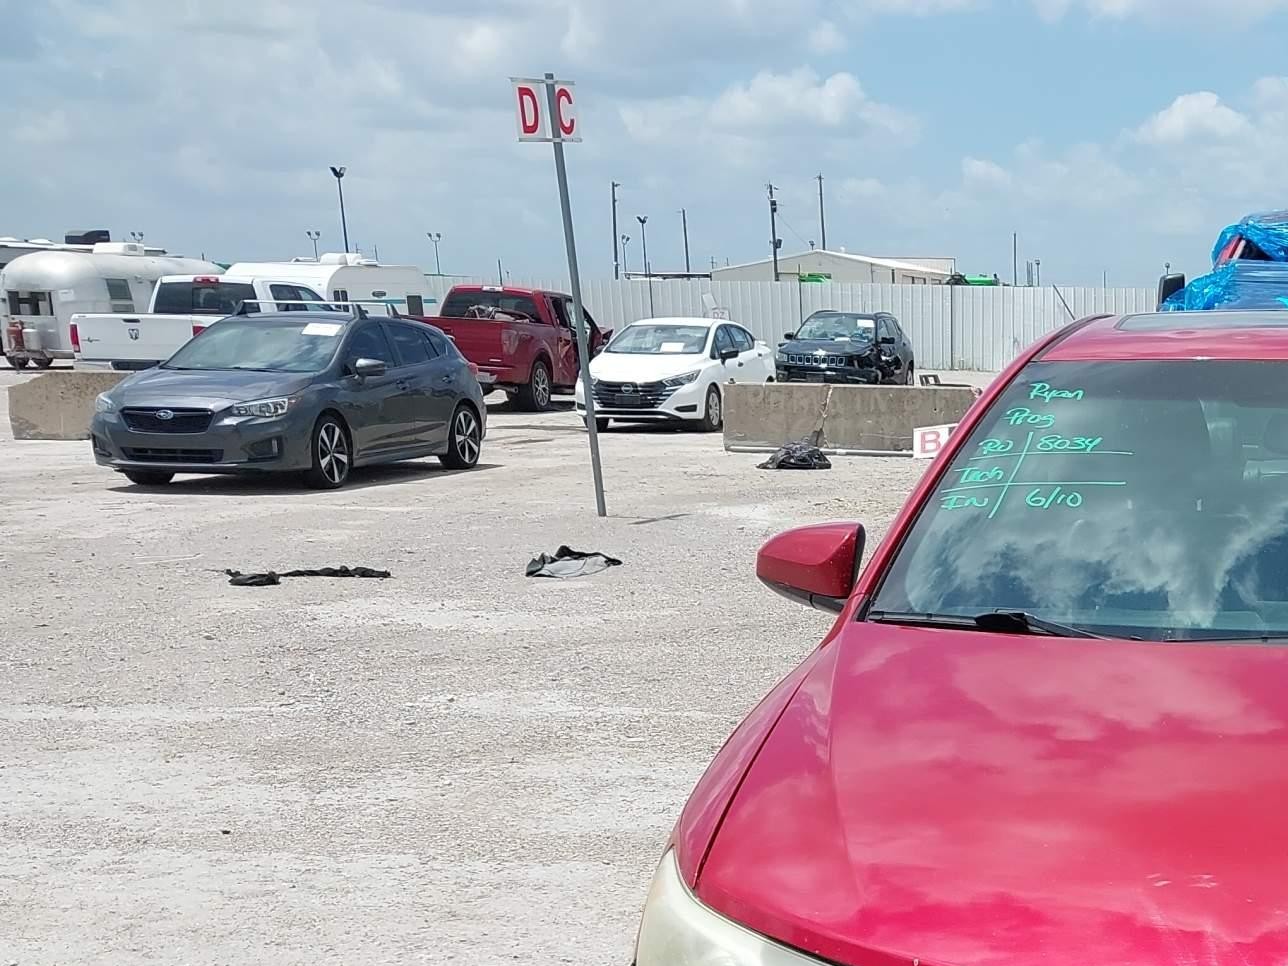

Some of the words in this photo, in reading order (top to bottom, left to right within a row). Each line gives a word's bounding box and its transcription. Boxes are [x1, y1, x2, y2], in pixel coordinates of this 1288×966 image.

[518, 86, 539, 134] D
[556, 88, 575, 135] C
[1030, 382, 1084, 402] Ryan
[920, 431, 941, 453] B
[1036, 434, 1103, 452] 8034
[1025, 486, 1082, 509] 6/10
